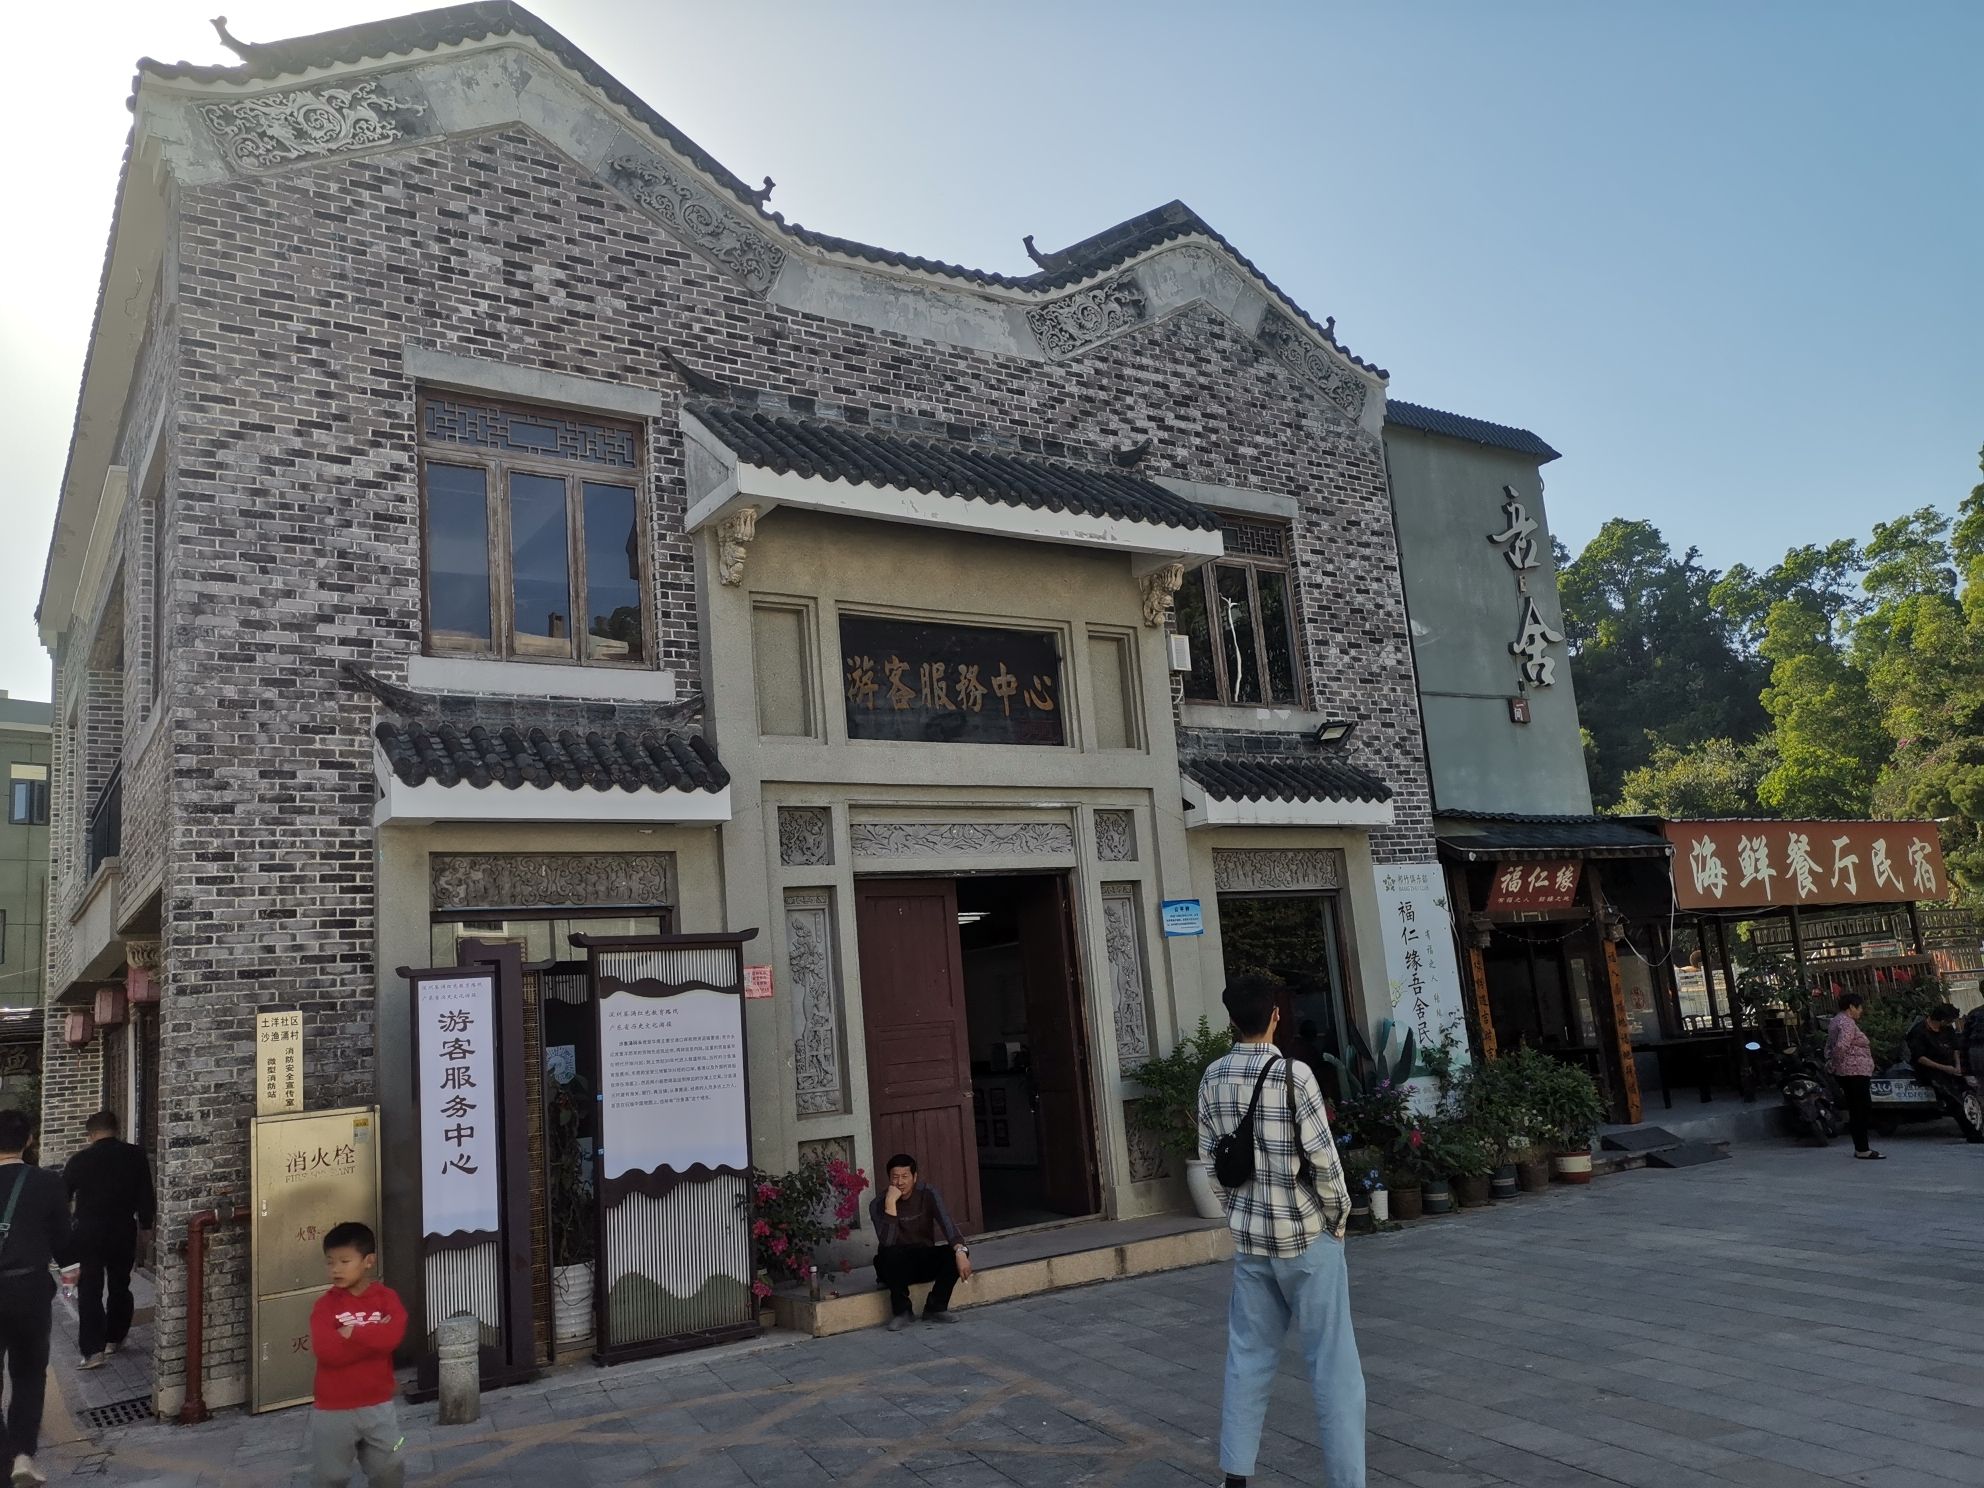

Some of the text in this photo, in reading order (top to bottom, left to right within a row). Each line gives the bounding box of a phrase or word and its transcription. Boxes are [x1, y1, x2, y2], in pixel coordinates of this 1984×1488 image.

[1690, 831, 1937, 901] 海鲜餐厅民宿
[261, 1016, 299, 1028] 土洋社区
[267, 1058, 277, 1098] 微型消防站
[285, 1047, 295, 1107] 消防安全宣传室
[437, 1009, 479, 1175] 游客服务中心
[285, 1143, 355, 1173] 消火栓
